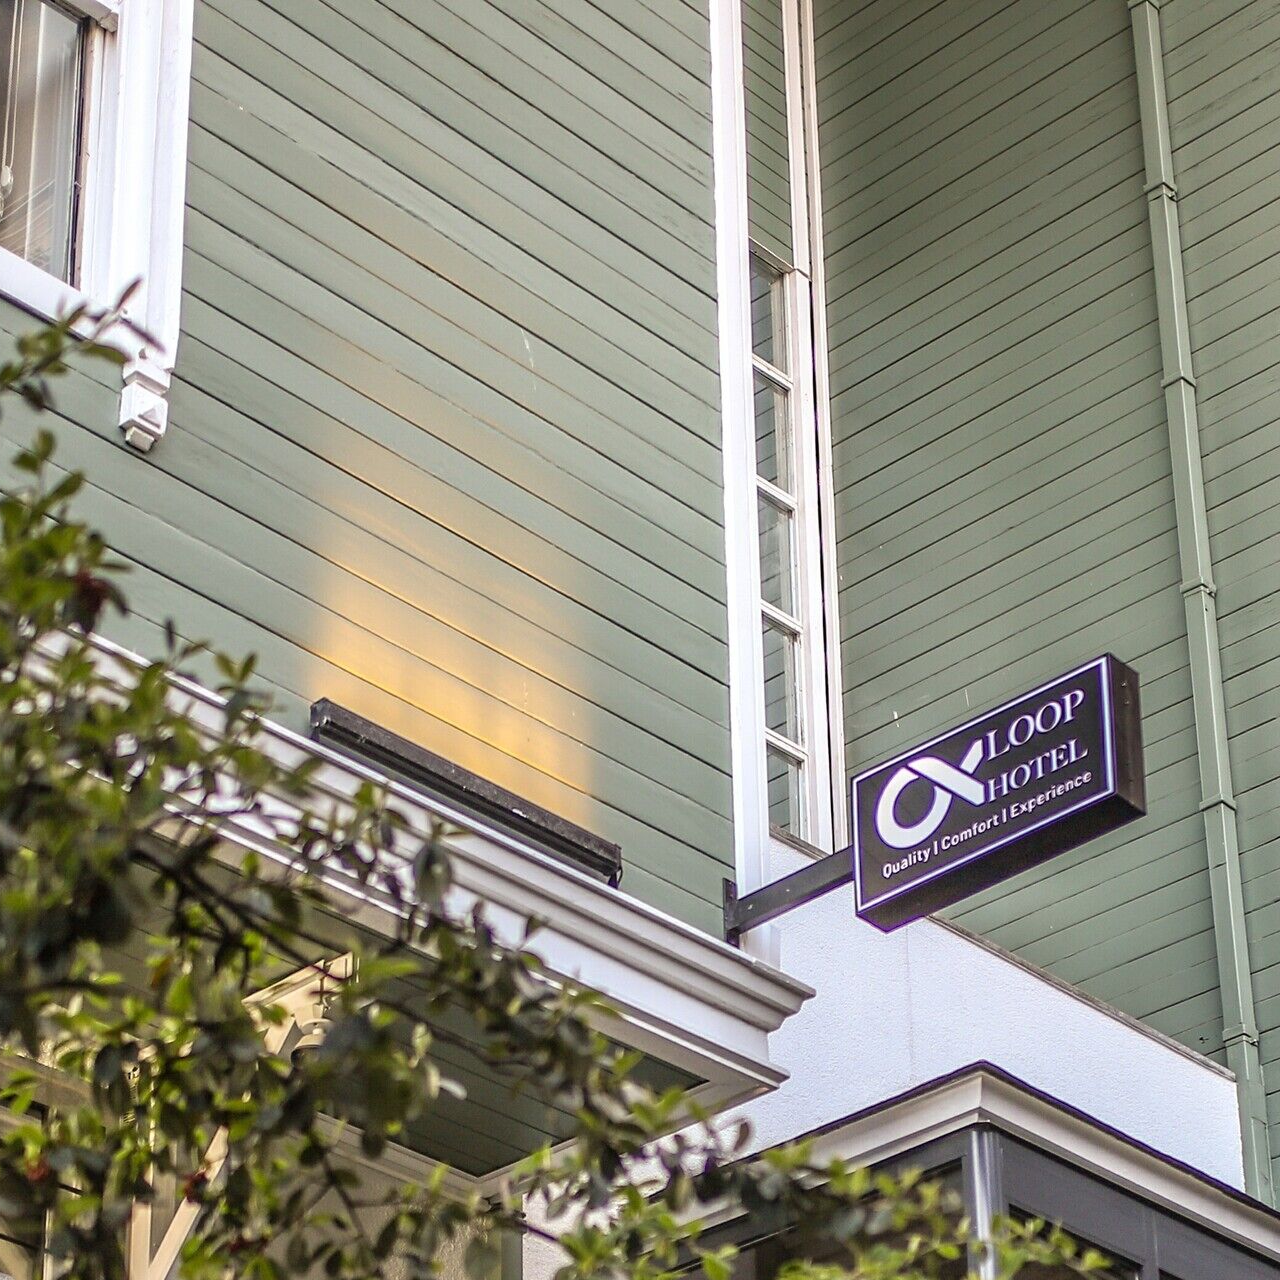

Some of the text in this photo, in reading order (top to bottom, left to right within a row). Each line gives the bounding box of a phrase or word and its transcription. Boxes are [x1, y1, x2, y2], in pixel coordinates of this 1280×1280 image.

[986, 689, 1085, 761] LOOP
[987, 738, 1089, 803] HOTEL
[882, 771, 1092, 879] Quality Comfort Experience
